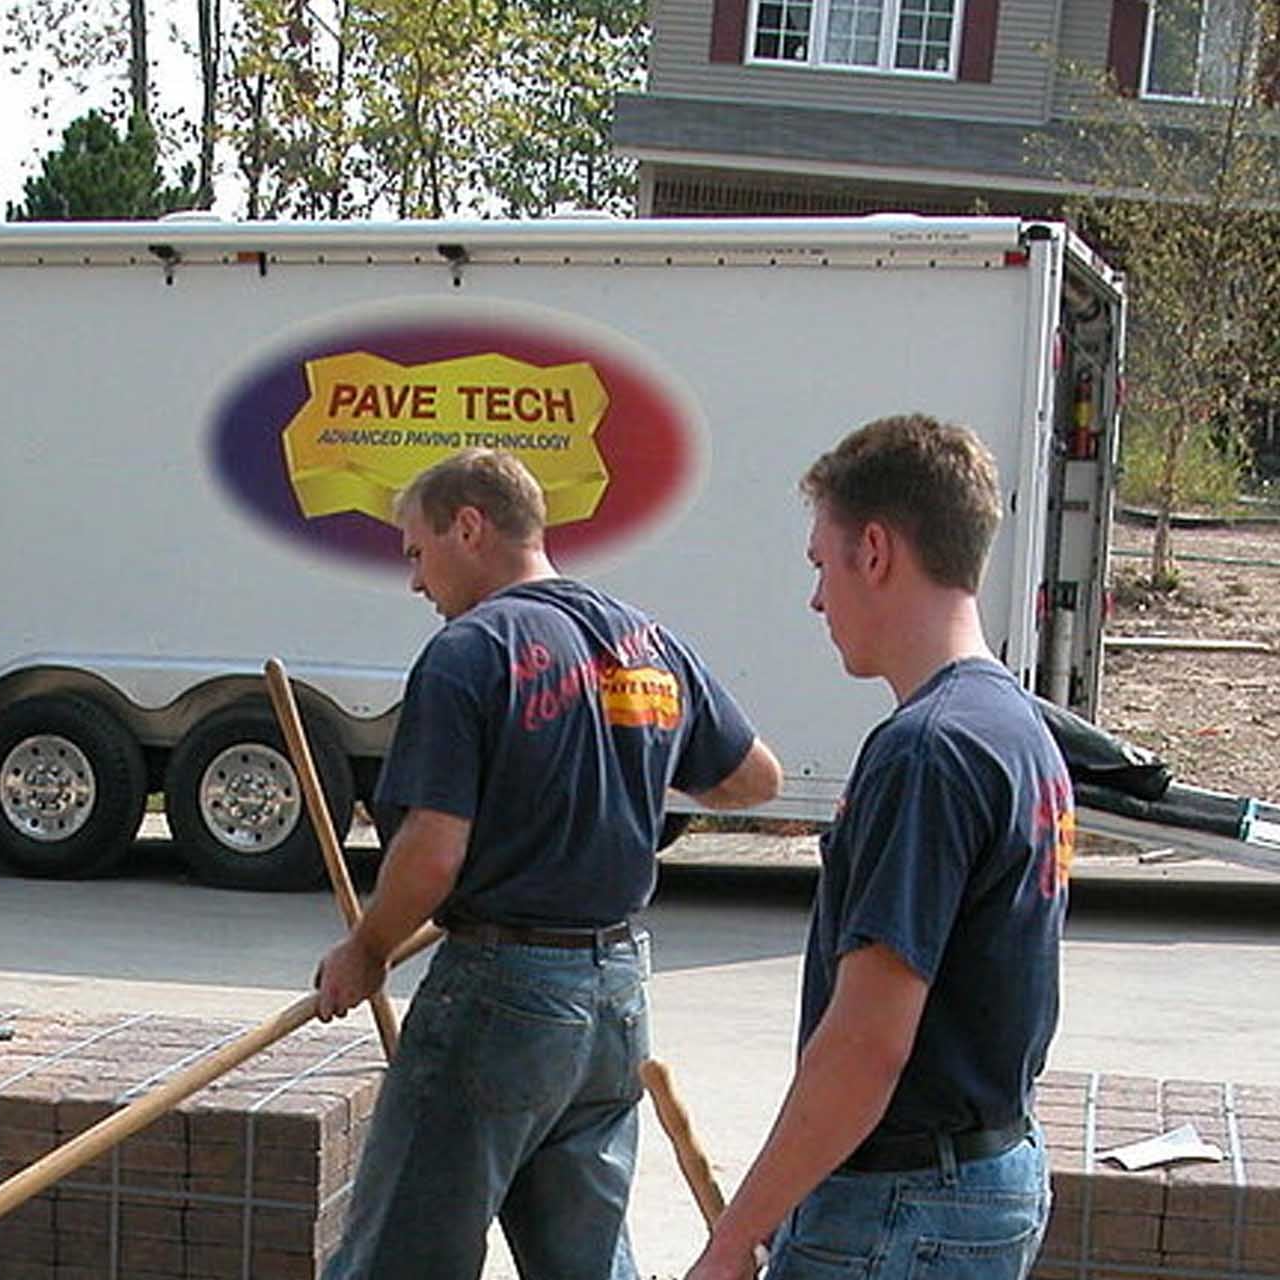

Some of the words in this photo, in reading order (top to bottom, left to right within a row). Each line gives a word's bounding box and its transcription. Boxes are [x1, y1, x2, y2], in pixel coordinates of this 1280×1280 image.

[328, 384, 438, 419] PAVE
[456, 385, 575, 423] TECH
[317, 430, 403, 446] ADVANCED
[404, 431, 461, 448] PAVING
[464, 431, 571, 450] TECHNOLOGY
